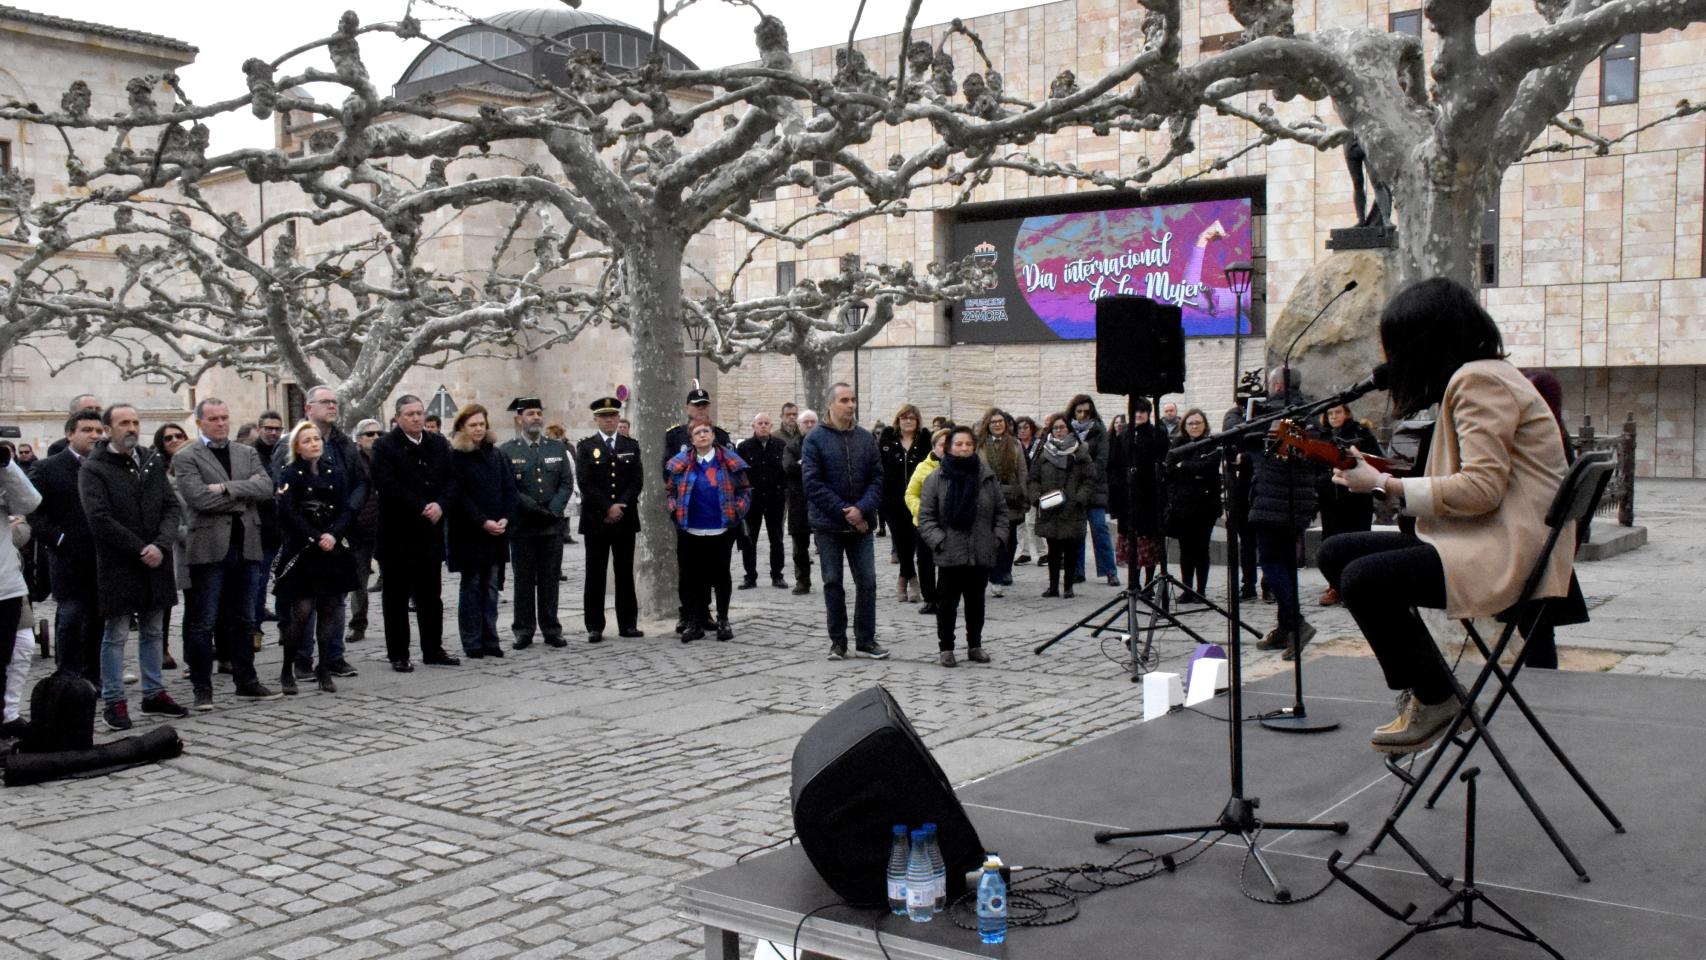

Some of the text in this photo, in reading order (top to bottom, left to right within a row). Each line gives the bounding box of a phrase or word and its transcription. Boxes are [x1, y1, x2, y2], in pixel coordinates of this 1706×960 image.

[1023, 232, 1173, 293] Día internacional
[1086, 271, 1208, 307] de la Mujer
[962, 310, 1009, 322] ZAMORA
